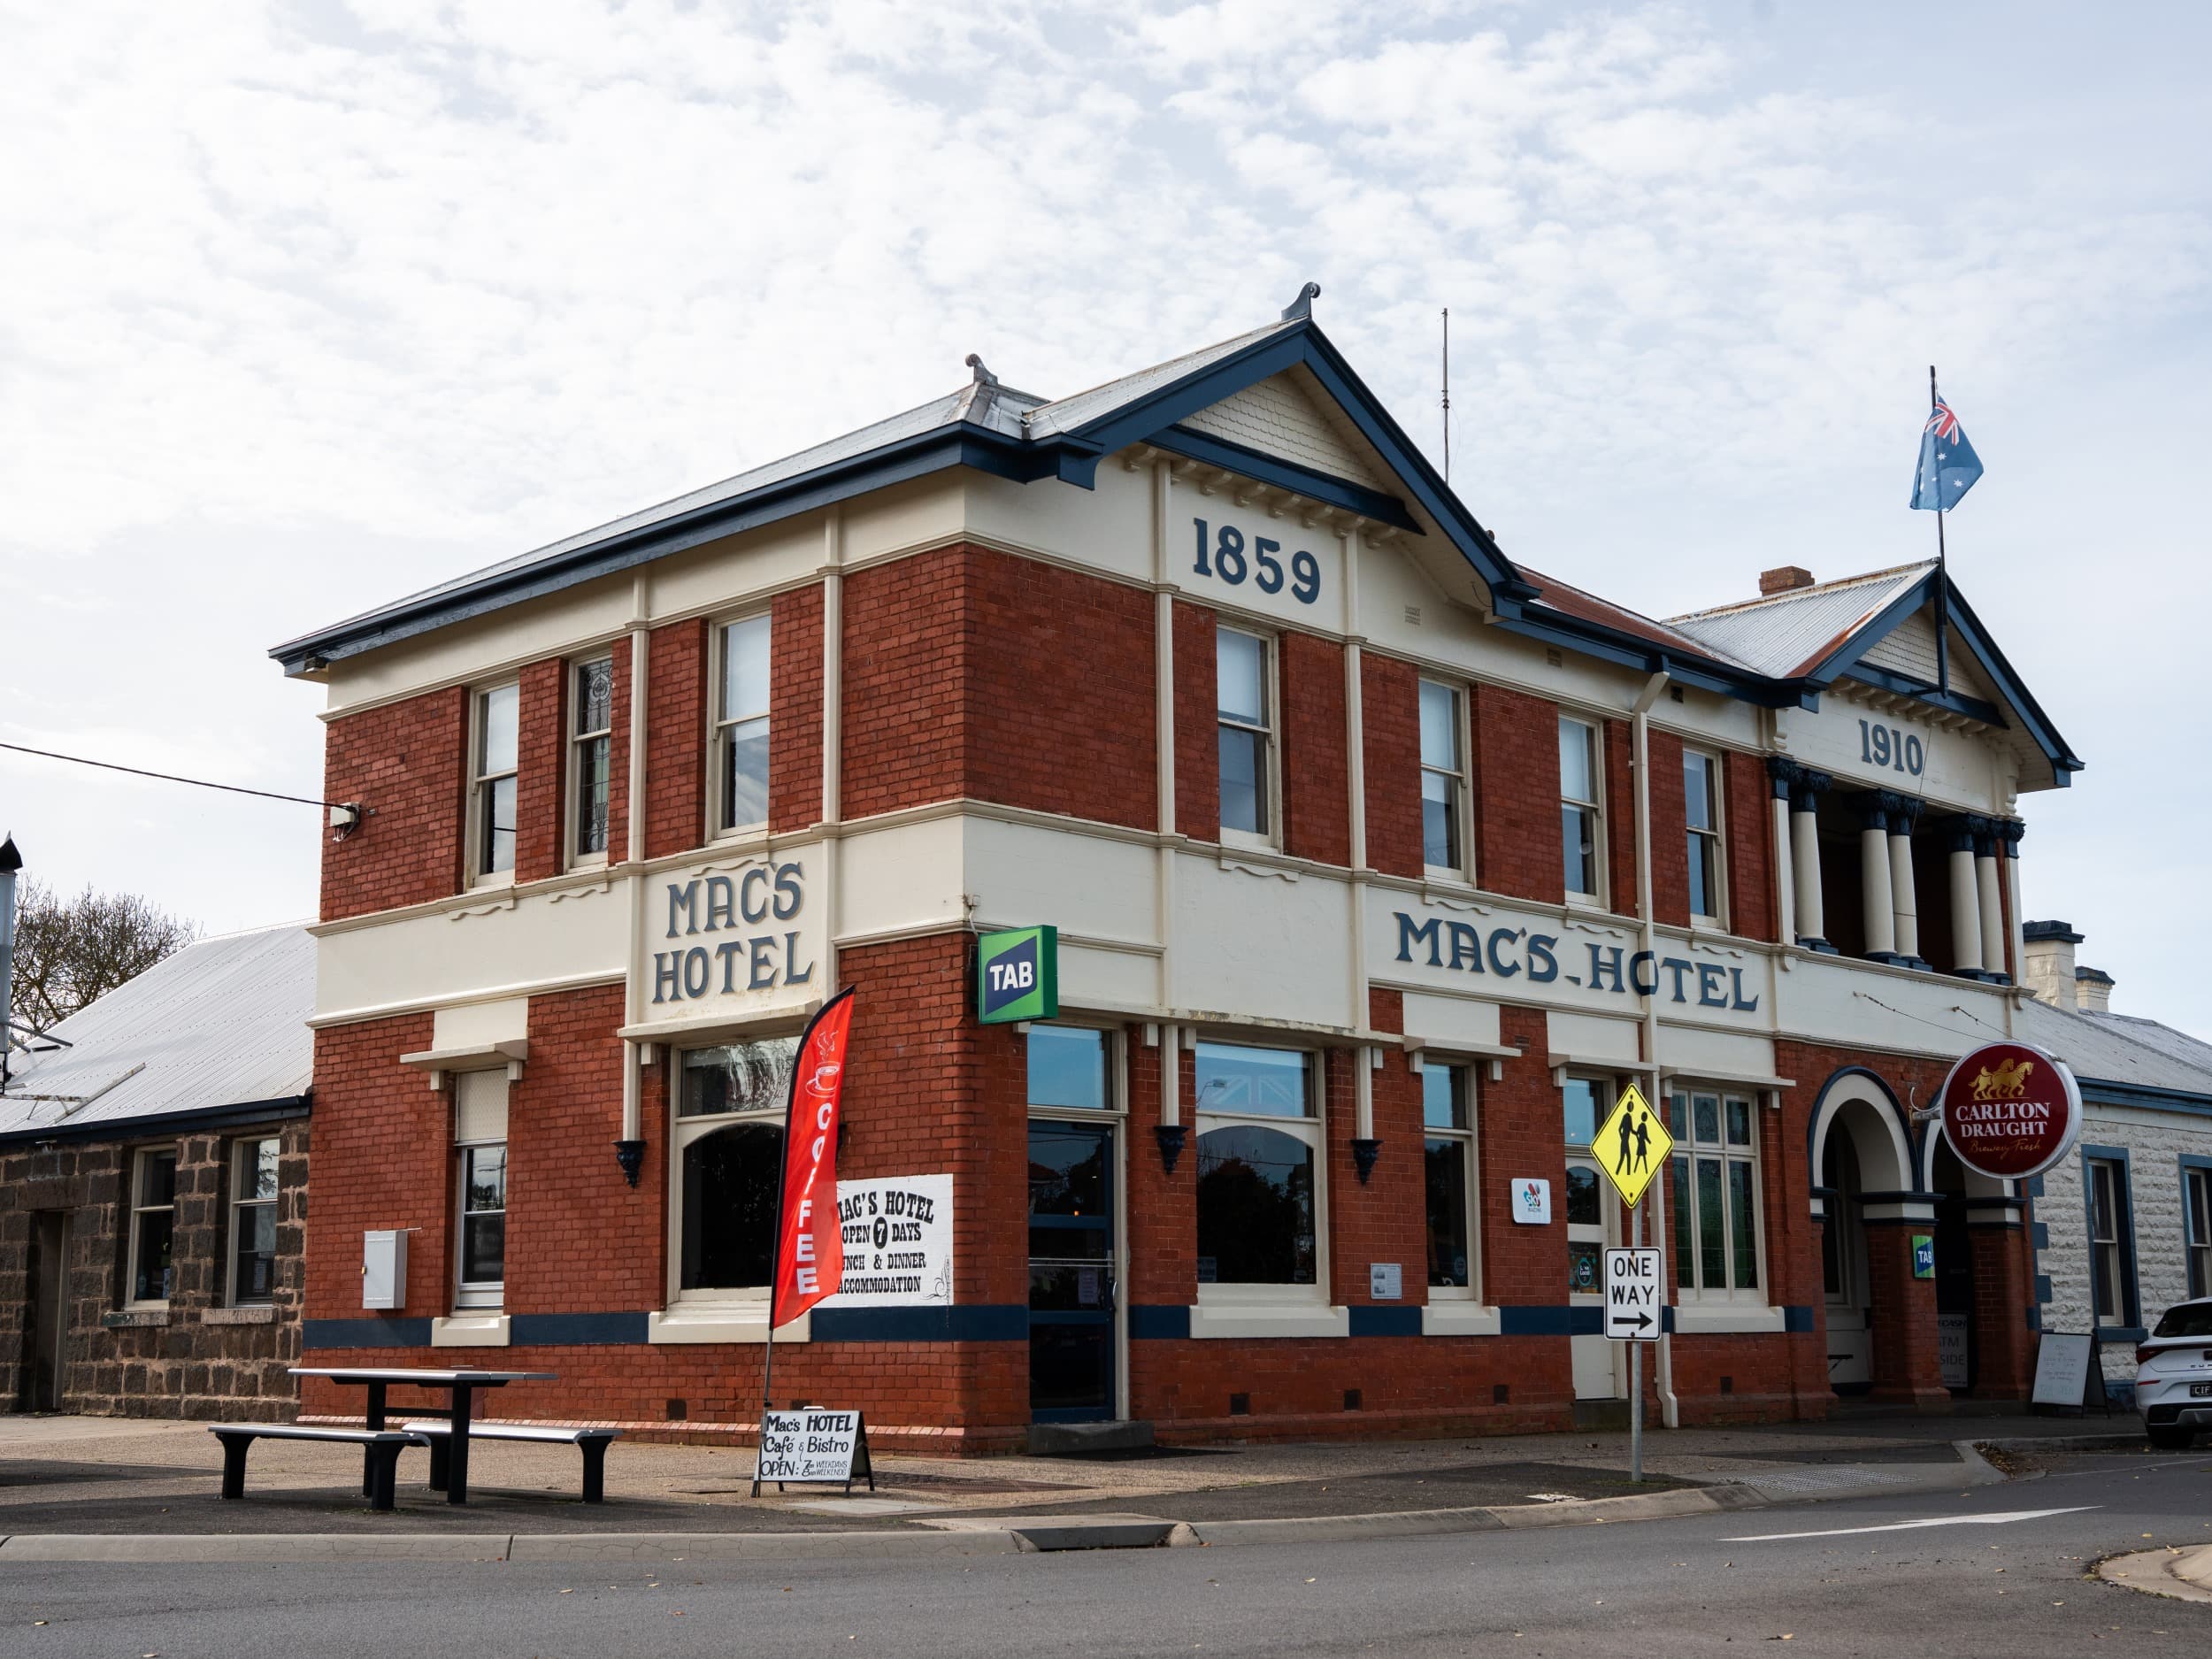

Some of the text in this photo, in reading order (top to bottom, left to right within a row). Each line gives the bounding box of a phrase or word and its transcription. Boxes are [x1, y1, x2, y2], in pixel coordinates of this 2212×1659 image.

[1194, 518, 1320, 604] 1859
[1859, 718, 1923, 776] 1910
[651, 932, 814, 1003] HOTEL
[989, 961, 1033, 991] TAB
[1586, 942, 1759, 1011] HOTEL
[1955, 1102, 2051, 1121] CARLTON
[1961, 1121, 2047, 1138] DRAUGHT
[2012, 1138, 2042, 1152] Fresh
[885, 1191, 934, 1225] HOTEL
[842, 1225, 871, 1244] OPEN
[892, 1222, 922, 1242] DAYS
[873, 1254, 883, 1270] &
[887, 1252, 927, 1269] DINNER
[1917, 1250, 1932, 1263] TAB
[1614, 1257, 1652, 1277] ONE
[1611, 1285, 1655, 1305] WAY
[766, 1414, 853, 1432] Mac's HOTEL
[764, 1435, 795, 1460] Café
[807, 1436, 849, 1453] Bistro
[816, 1460, 848, 1469] WEEKDAYS
